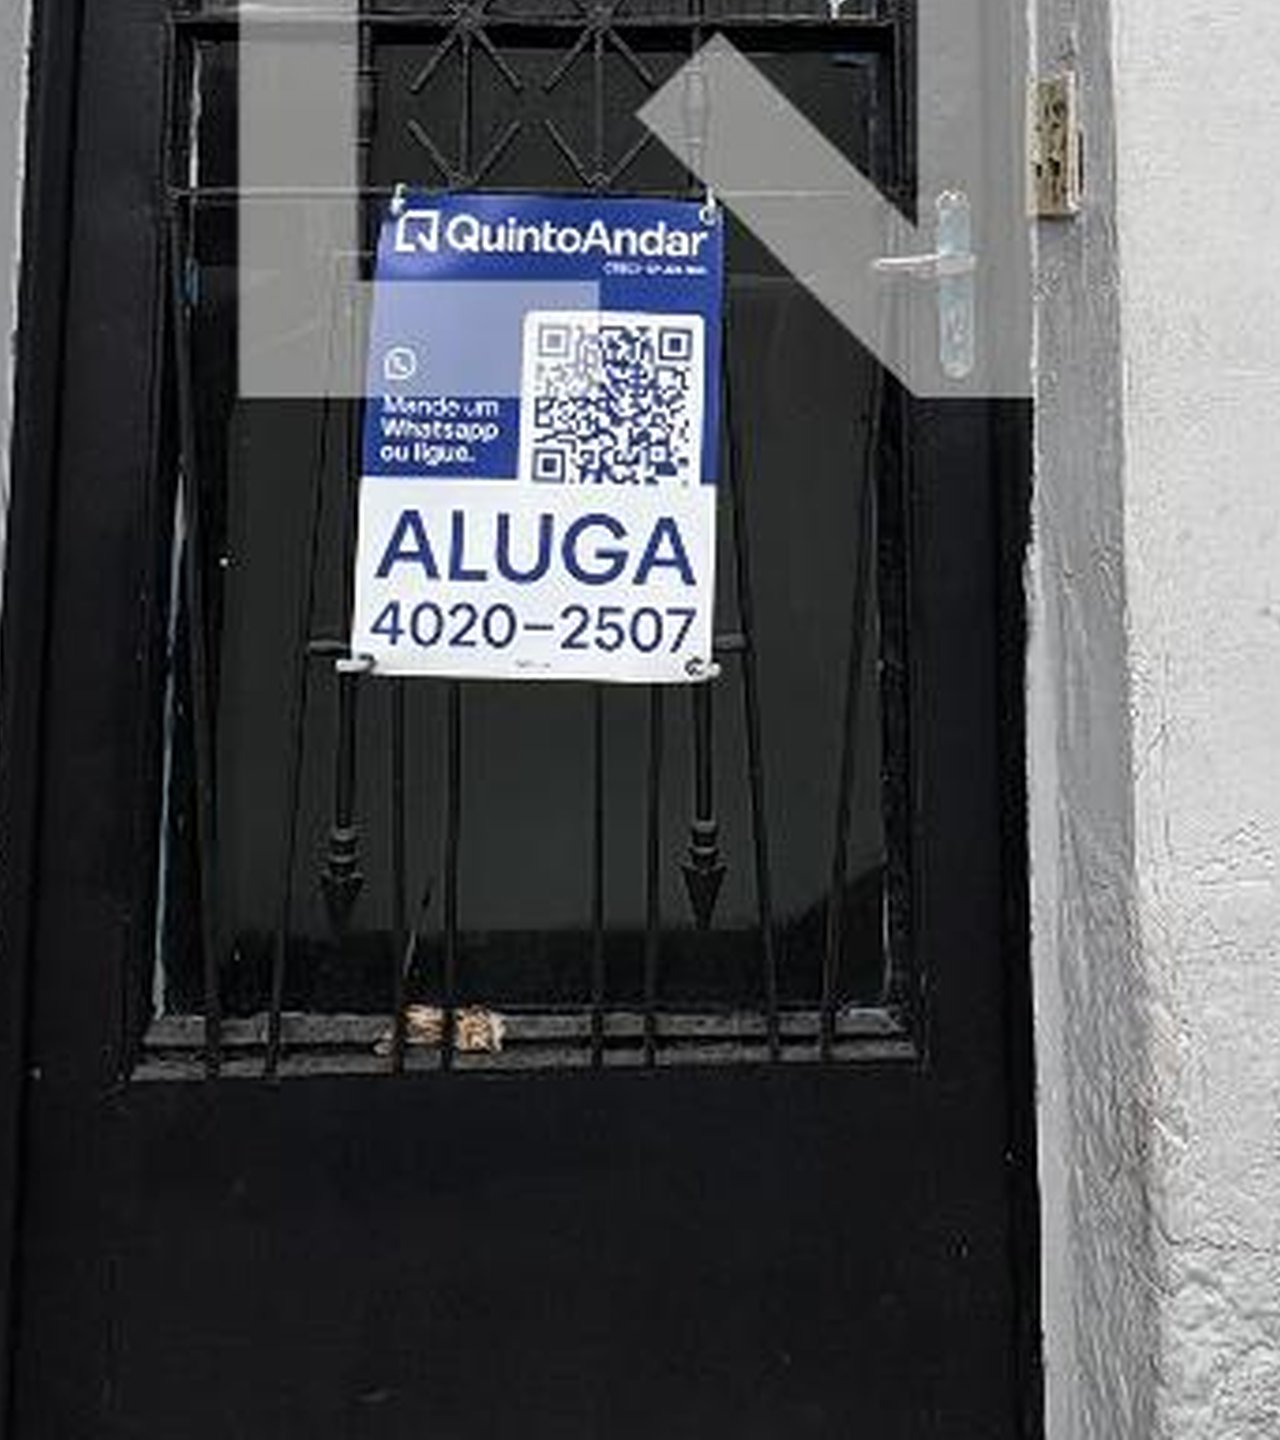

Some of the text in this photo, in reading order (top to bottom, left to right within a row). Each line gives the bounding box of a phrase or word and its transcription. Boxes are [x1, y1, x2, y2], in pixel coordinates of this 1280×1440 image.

[447, 214, 708, 257] QuintoAndar
[465, 401, 499, 418] um
[380, 445, 408, 462] ou
[374, 509, 697, 586] ALUGA
[370, 600, 697, 653] 4020-2507
